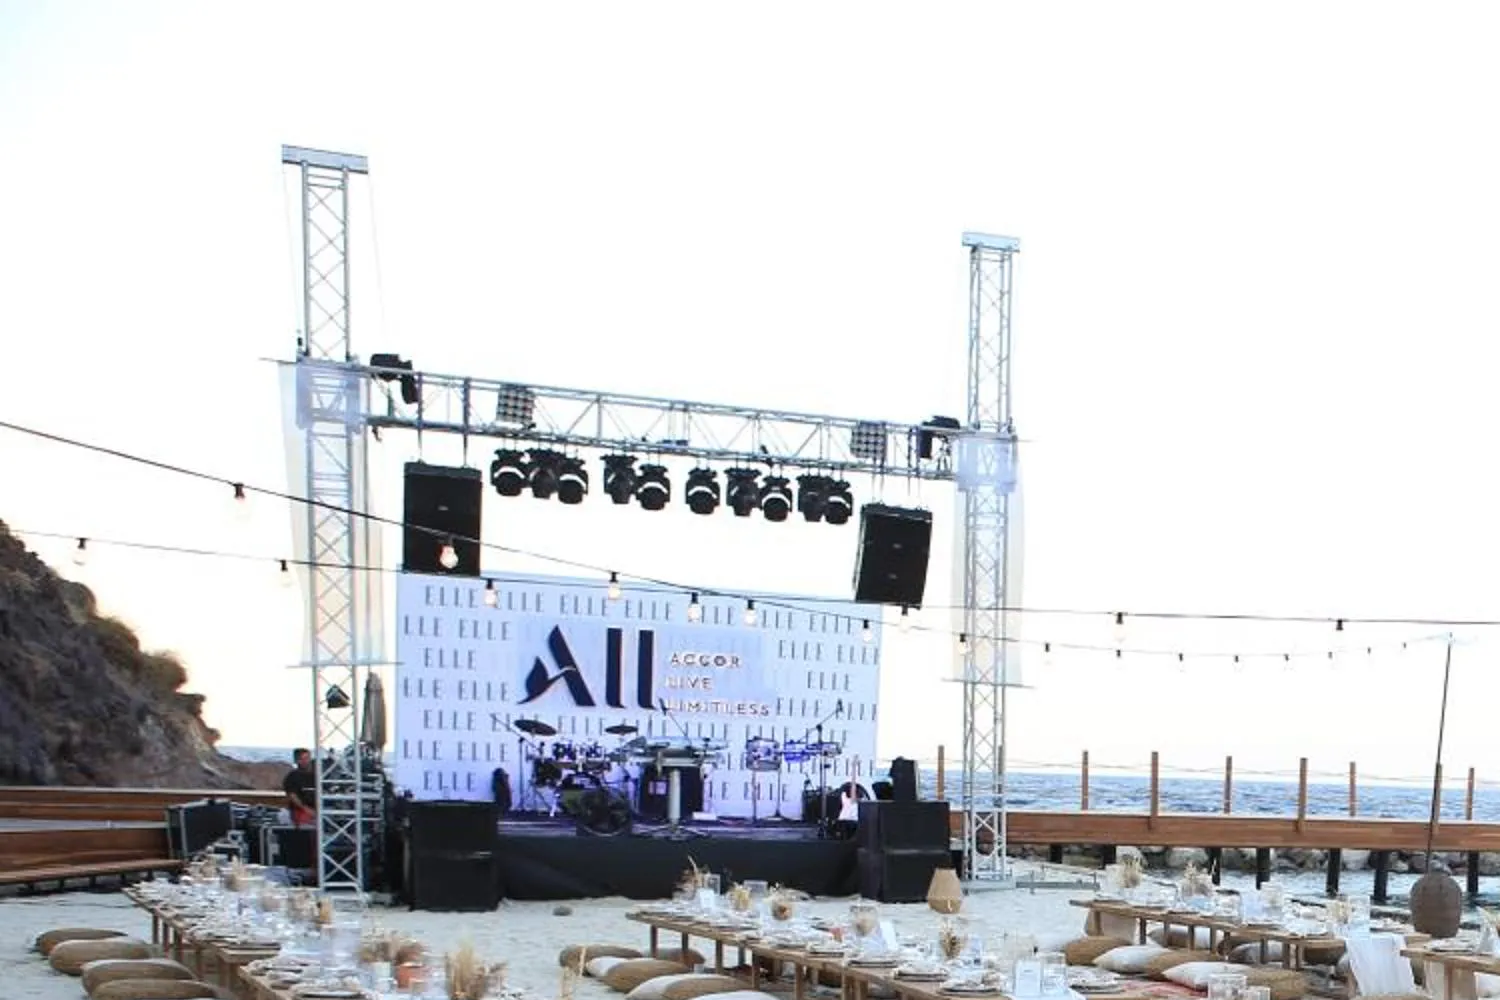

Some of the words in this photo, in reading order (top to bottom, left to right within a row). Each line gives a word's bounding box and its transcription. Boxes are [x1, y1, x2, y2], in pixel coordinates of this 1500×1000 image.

[424, 585, 478, 608] ELLE
[560, 592, 609, 617] ELLE
[625, 599, 672, 621] ELLE
[688, 605, 736, 625] LLE
[762, 609, 796, 631] LLE
[404, 614, 441, 637] LLE
[459, 617, 511, 641] ELLE
[424, 646, 476, 671] ELLE
[671, 653, 741, 668] ACCOR
[779, 639, 825, 661] ELLE
[403, 677, 441, 699] LLE
[458, 679, 510, 701] ELLE
[668, 677, 713, 690] LIVE
[807, 670, 853, 692] ELLE
[668, 700, 769, 716] LIMITLESS
[777, 697, 822, 718] ELLE
[424, 709, 475, 731] ELLE
[558, 715, 607, 738] ELLE
[403, 740, 441, 760] LLE
[458, 742, 509, 762] ELLE
[424, 771, 475, 792] ELLE
